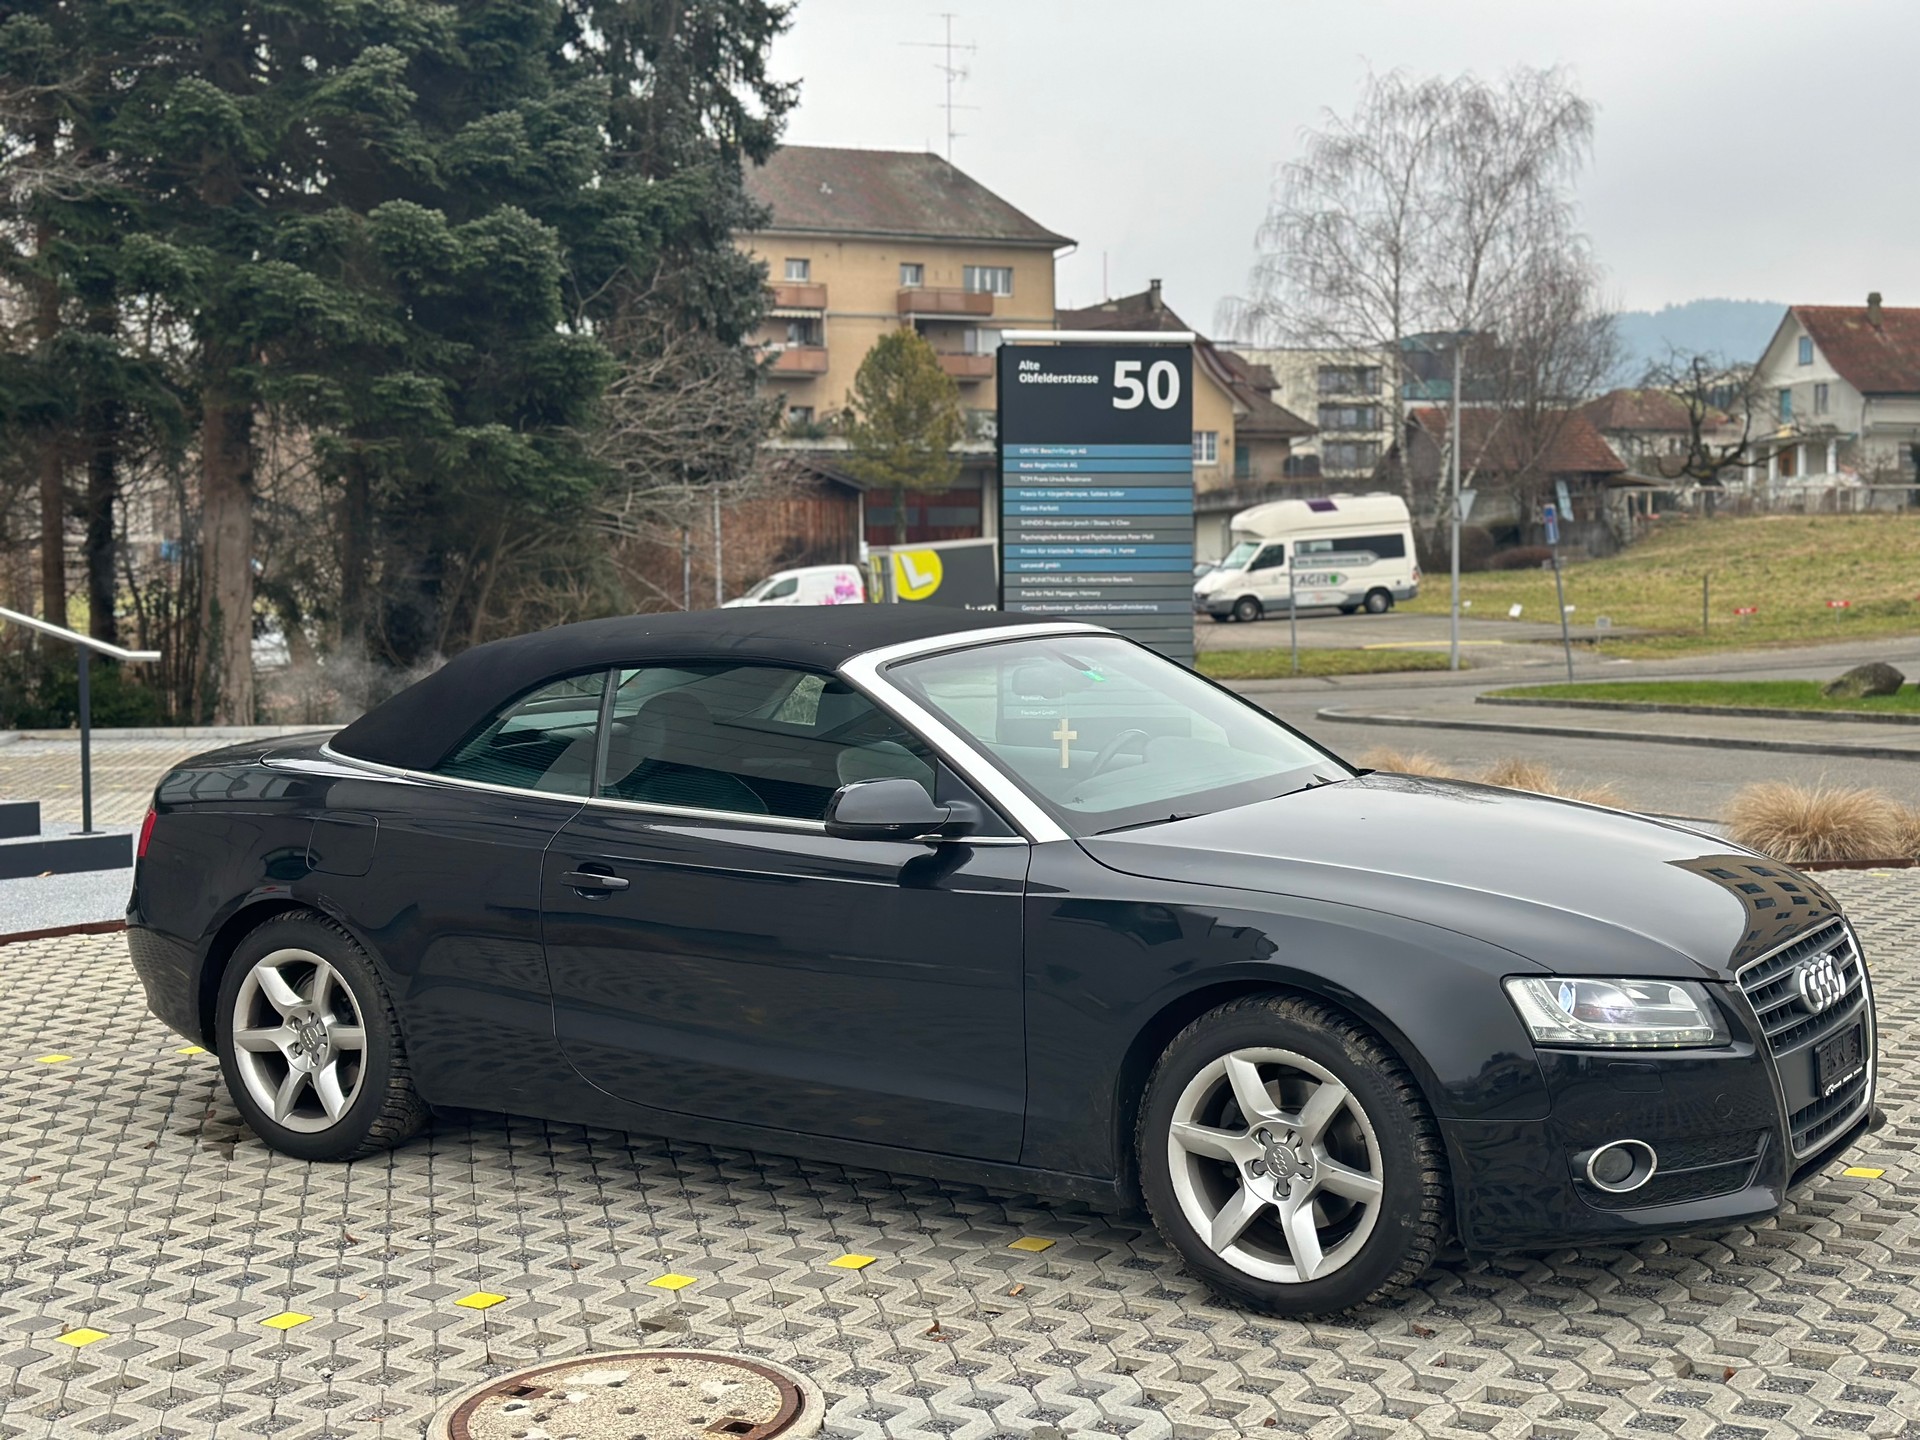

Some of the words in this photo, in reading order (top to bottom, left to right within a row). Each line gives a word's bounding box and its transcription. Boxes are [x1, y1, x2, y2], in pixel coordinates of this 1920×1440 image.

[1018, 360, 1040, 371] Alte
[1018, 372, 1099, 384] Obfelderstrasse
[1112, 360, 1181, 410] 50
